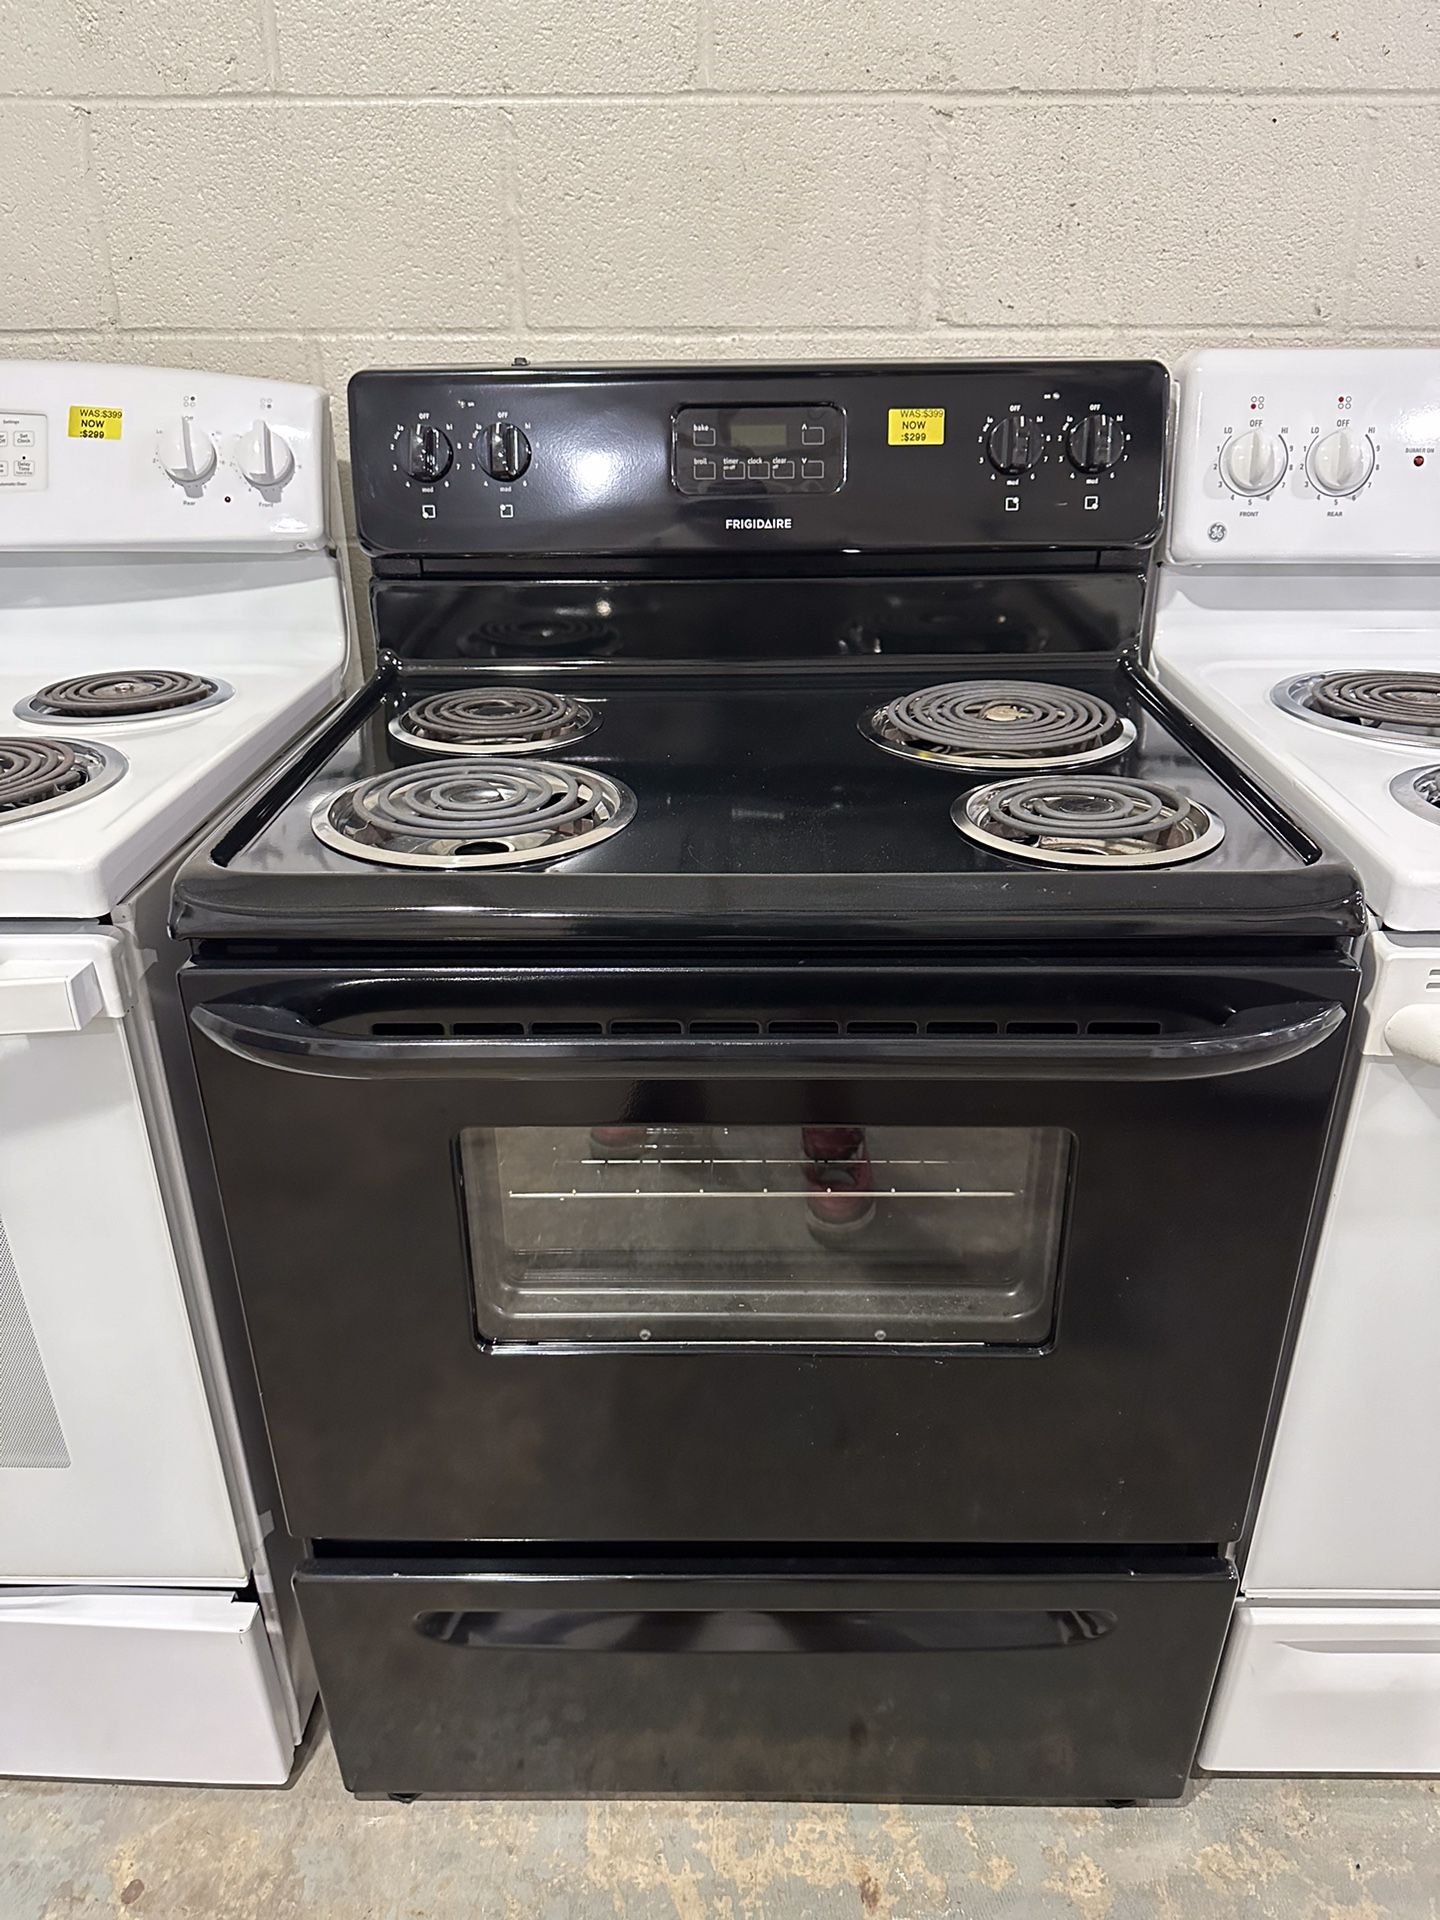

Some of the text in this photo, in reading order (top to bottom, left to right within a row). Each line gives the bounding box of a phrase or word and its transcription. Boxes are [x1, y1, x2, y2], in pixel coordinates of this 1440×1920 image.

[902, 421, 926, 429] NOW
[901, 433, 926, 441] :$299
[725, 518, 792, 529] FRIGIDAIRE
